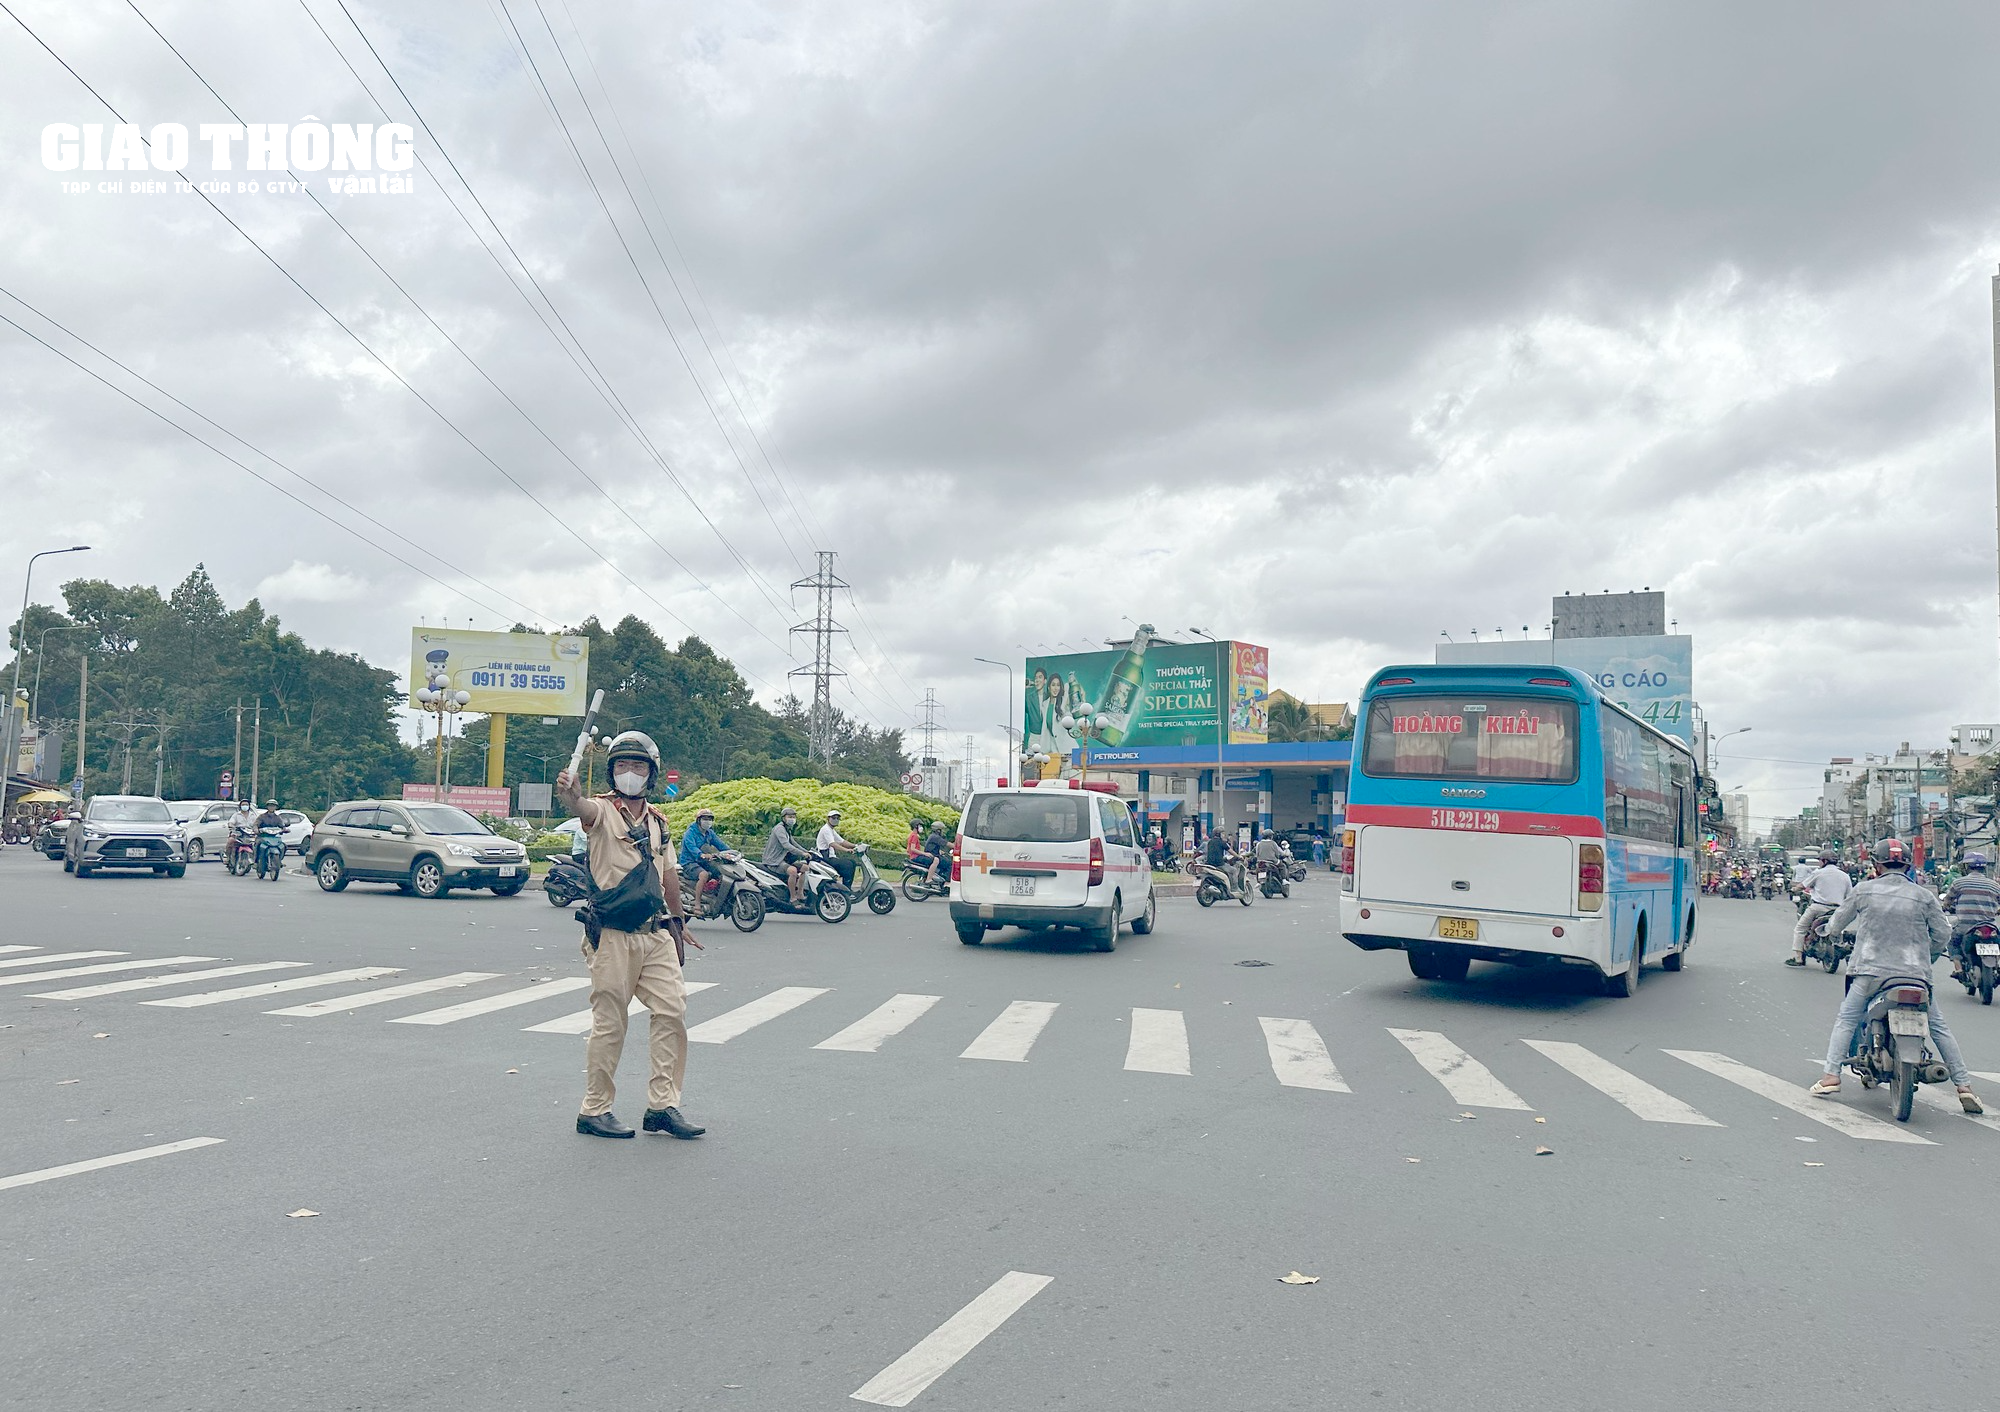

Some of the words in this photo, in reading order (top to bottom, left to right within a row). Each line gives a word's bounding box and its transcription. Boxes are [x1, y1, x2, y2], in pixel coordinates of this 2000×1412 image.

[488, 661, 503, 670] LIÊN
[504, 662, 513, 672] HỆ
[514, 662, 536, 672] QUẢNG
[537, 663, 551, 673] CÁO
[1156, 665, 1194, 677] THƯỞNG
[1195, 666, 1205, 677] VỊ
[471, 671, 505, 687] 0911
[510, 673, 528, 689] 39
[531, 675, 566, 690] 5555
[1149, 681, 1188, 691] SPECIAL
[1189, 677, 1212, 691] THẬT
[1622, 669, 1668, 688] CÁO
[1144, 693, 1217, 711] SPECIAL
[1393, 710, 1463, 734] HOÀNG
[1486, 709, 1540, 735] KHẢI
[1094, 752, 1140, 760] PETROLIMEX
[1441, 787, 1488, 799] SAMCO
[1431, 809, 1500, 830] 51B.221.29
[1450, 919, 1468, 929] 51B
